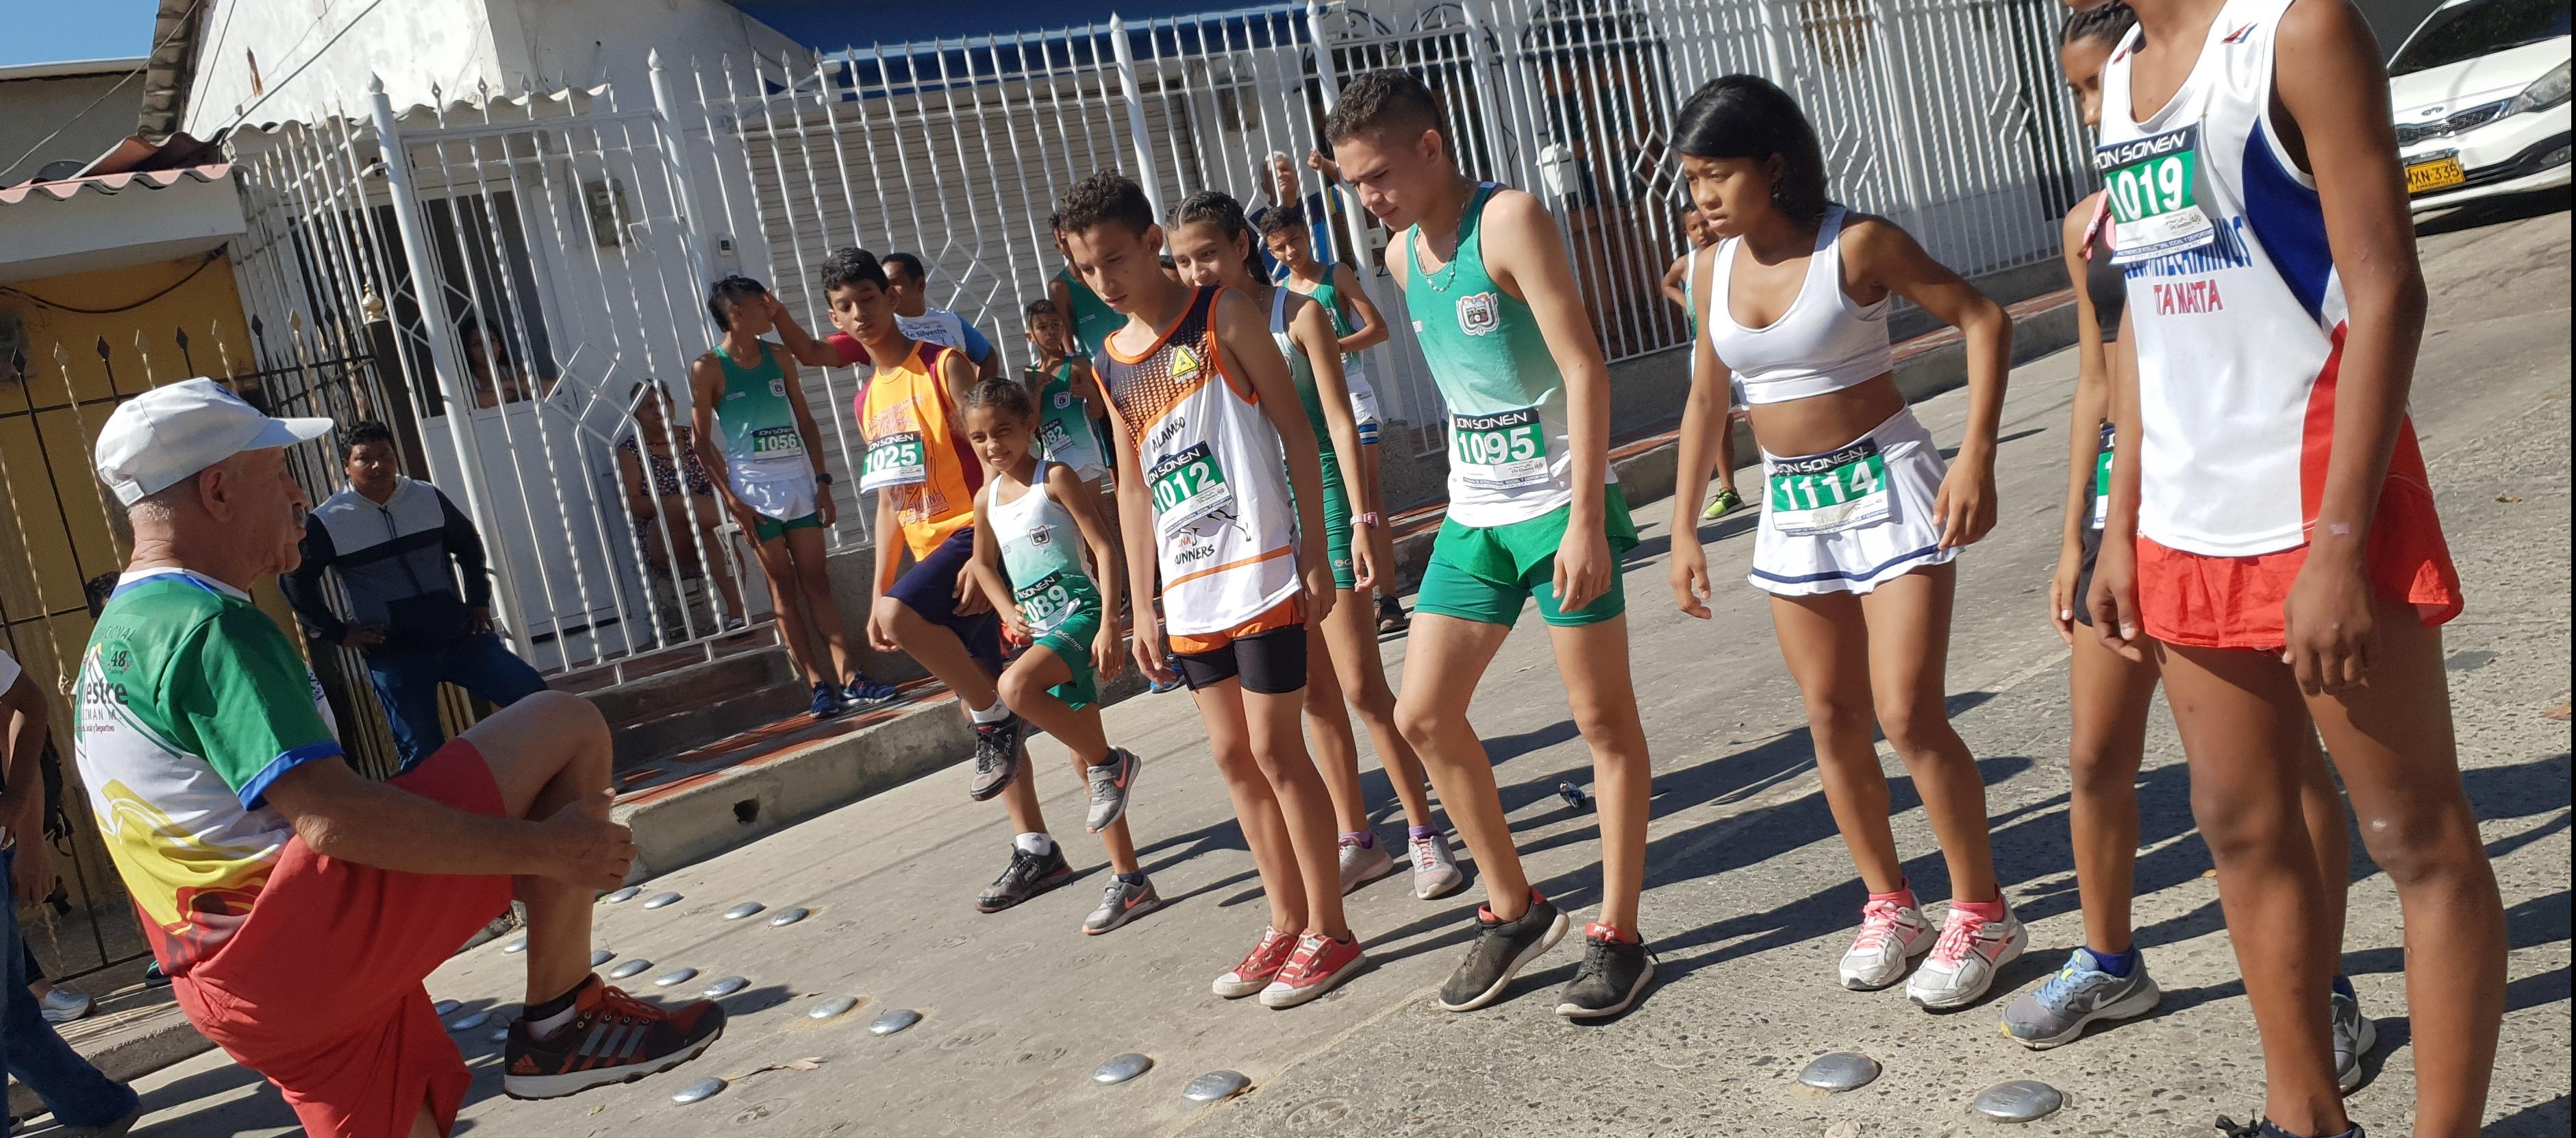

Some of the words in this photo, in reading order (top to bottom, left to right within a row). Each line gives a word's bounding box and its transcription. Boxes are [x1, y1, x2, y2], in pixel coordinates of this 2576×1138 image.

[2121, 131, 2186, 164] SONEN
[2105, 156, 2183, 223] 1019
[1473, 412, 1527, 430] SONEN
[758, 433, 797, 452] 1056
[880, 433, 914, 447] SONEN
[1459, 427, 1535, 465] 1095
[865, 443, 917, 475] 1025
[1158, 448, 1201, 478] SONEN
[1154, 461, 1216, 512] 1012
[1779, 460, 1879, 510] 1114
[1025, 585, 1070, 623] 089
[110, 650, 127, 667] 48
